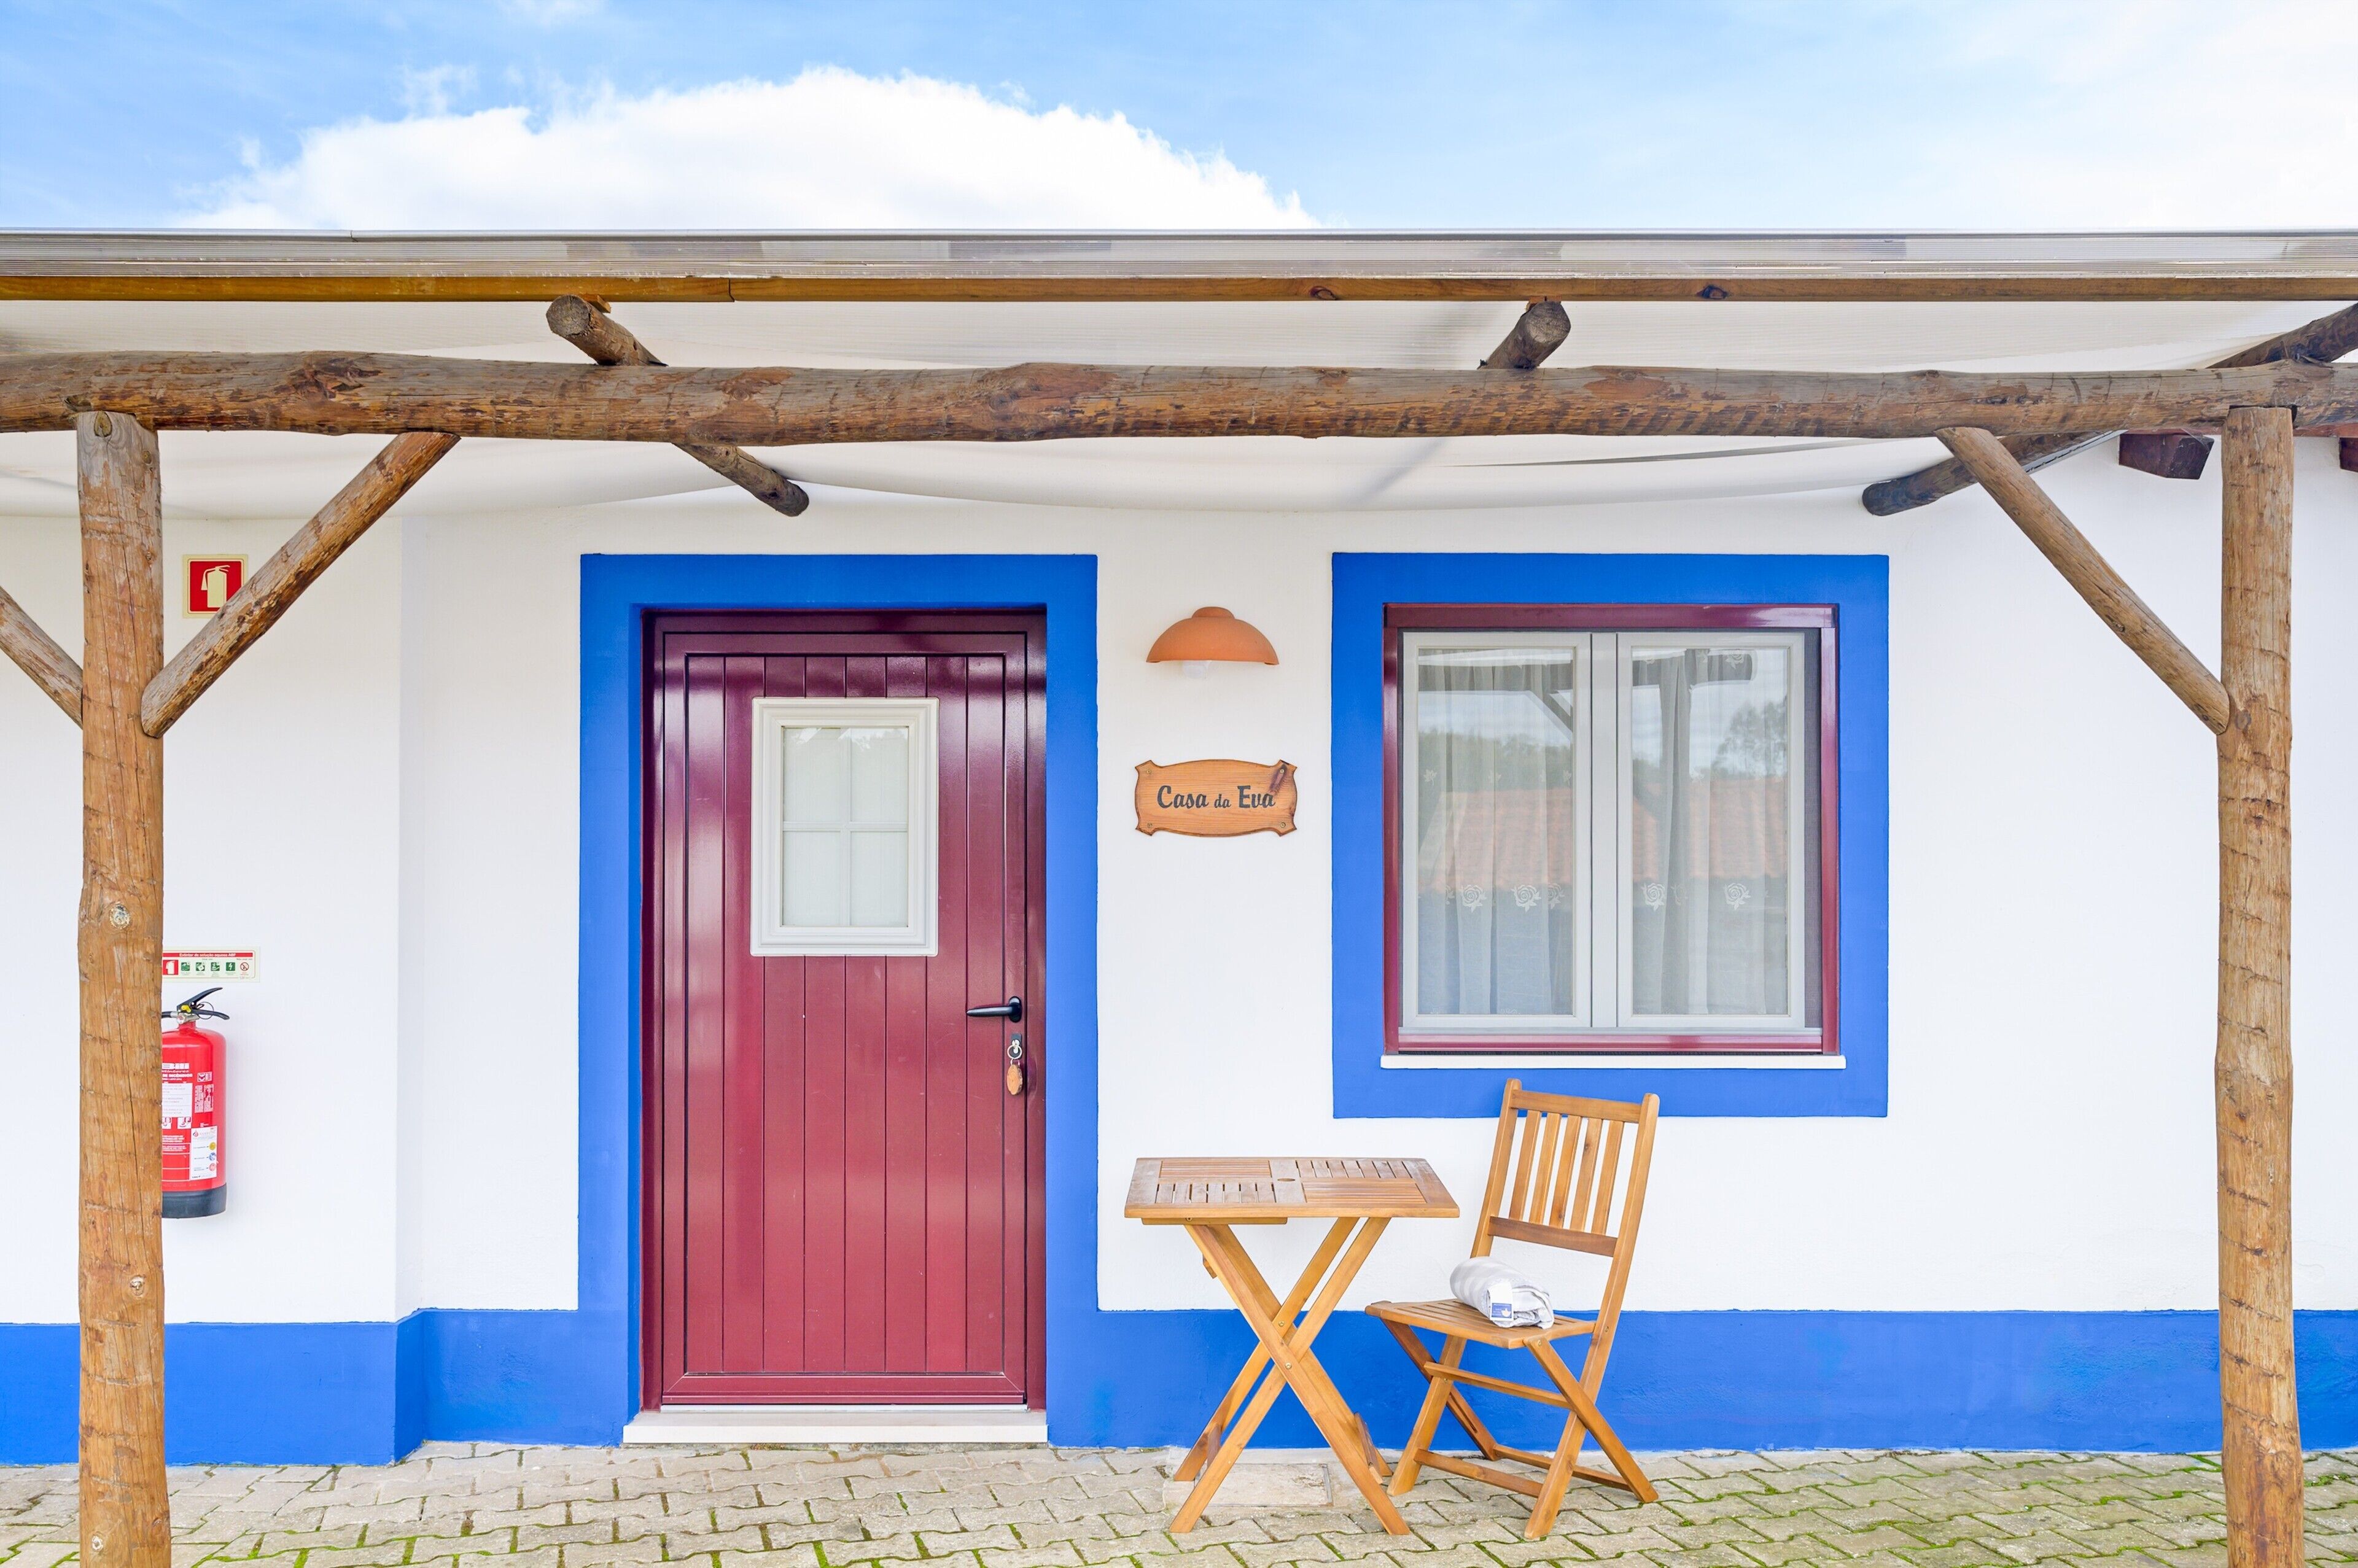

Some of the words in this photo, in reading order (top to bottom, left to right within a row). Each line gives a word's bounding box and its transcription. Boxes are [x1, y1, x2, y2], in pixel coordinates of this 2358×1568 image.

[1157, 785, 1209, 809] Casa
[1214, 794, 1231, 809] da
[1237, 785, 1275, 809] Eva
